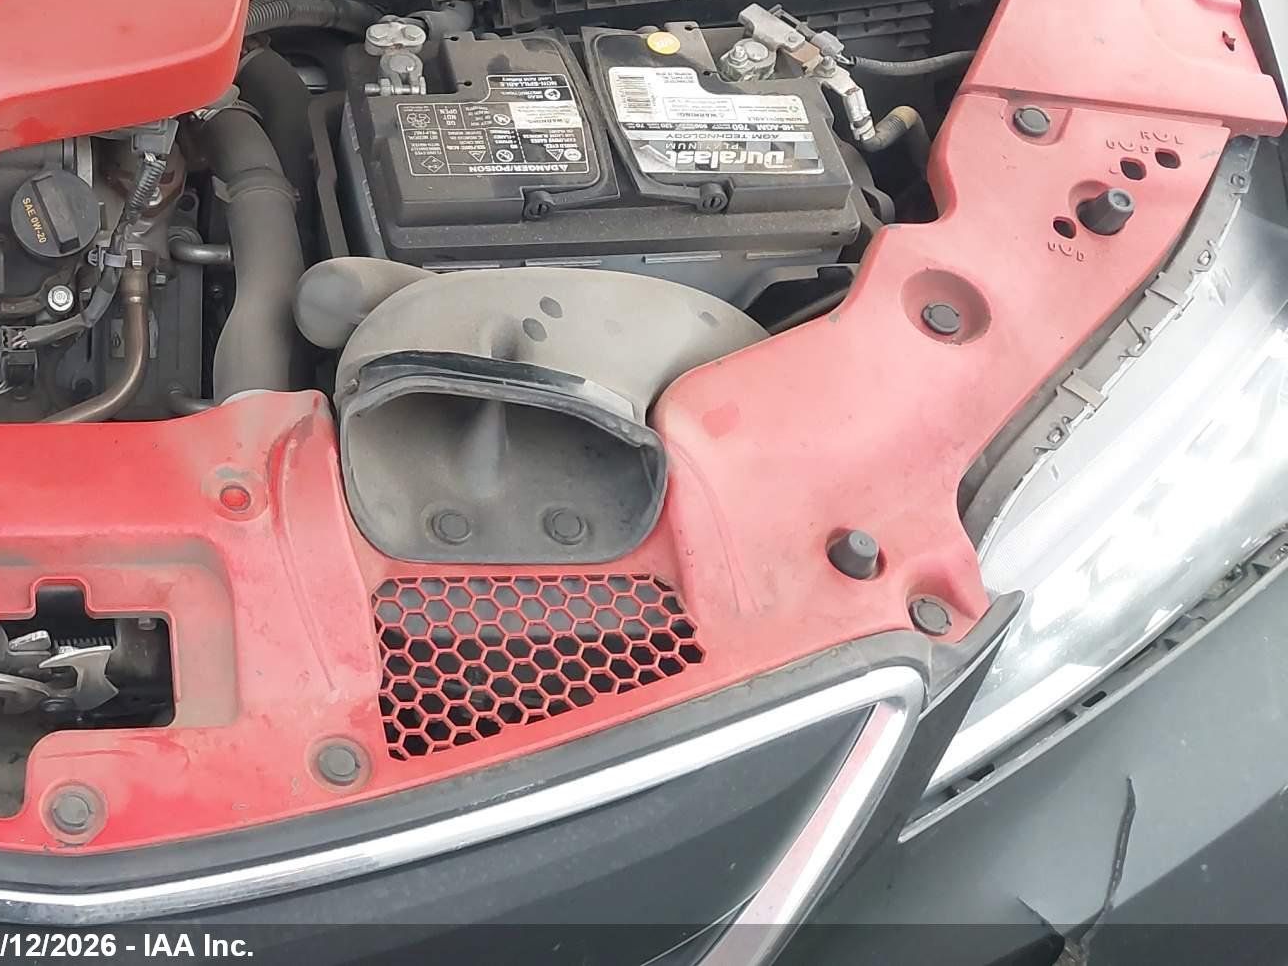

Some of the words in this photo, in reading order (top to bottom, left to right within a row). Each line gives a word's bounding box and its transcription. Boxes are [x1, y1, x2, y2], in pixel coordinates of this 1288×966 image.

[665, 151, 793, 169] Duralast
[22, 197, 36, 217] SAE
[30, 217, 47, 243] 0W-20
